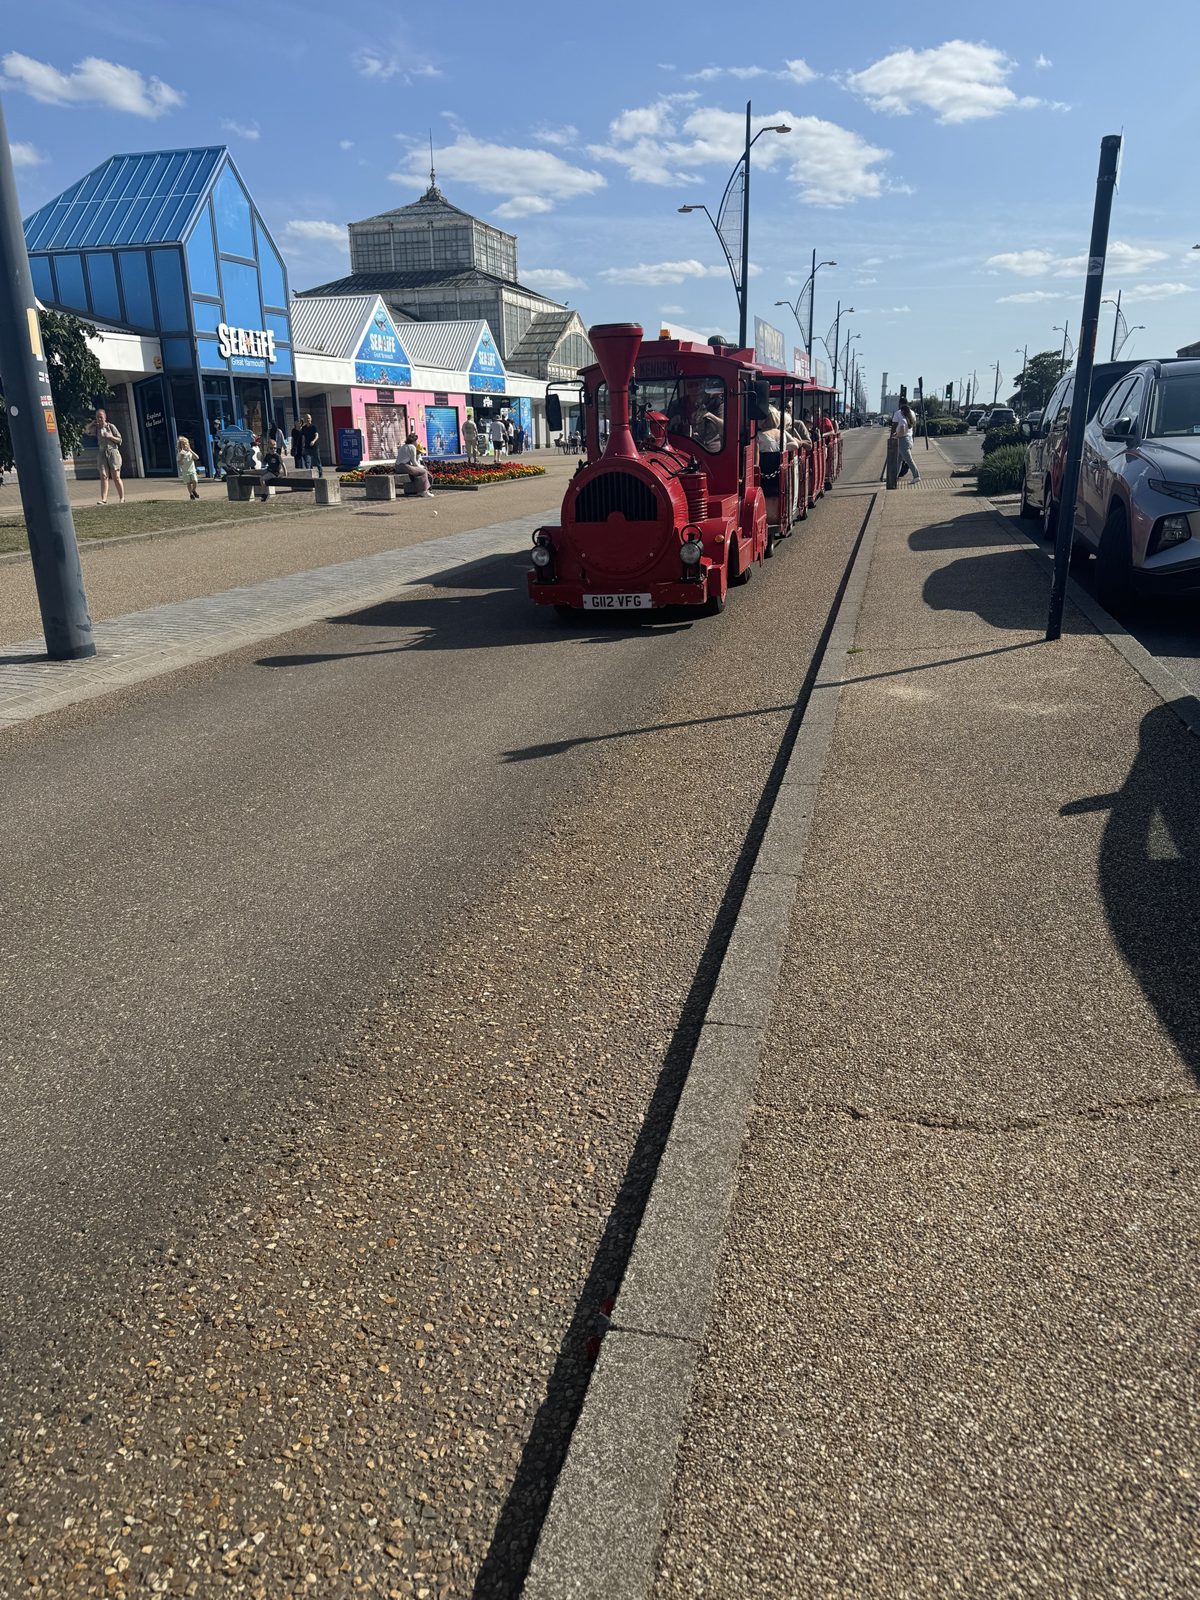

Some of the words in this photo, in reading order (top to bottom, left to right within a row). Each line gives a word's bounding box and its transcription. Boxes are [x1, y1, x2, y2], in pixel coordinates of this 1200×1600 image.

[218, 323, 249, 358] SEA
[231, 357, 245, 366] Great
[245, 359, 266, 367] Yarmouth
[591, 596, 615, 608] G112
[617, 595, 642, 607] VFG
